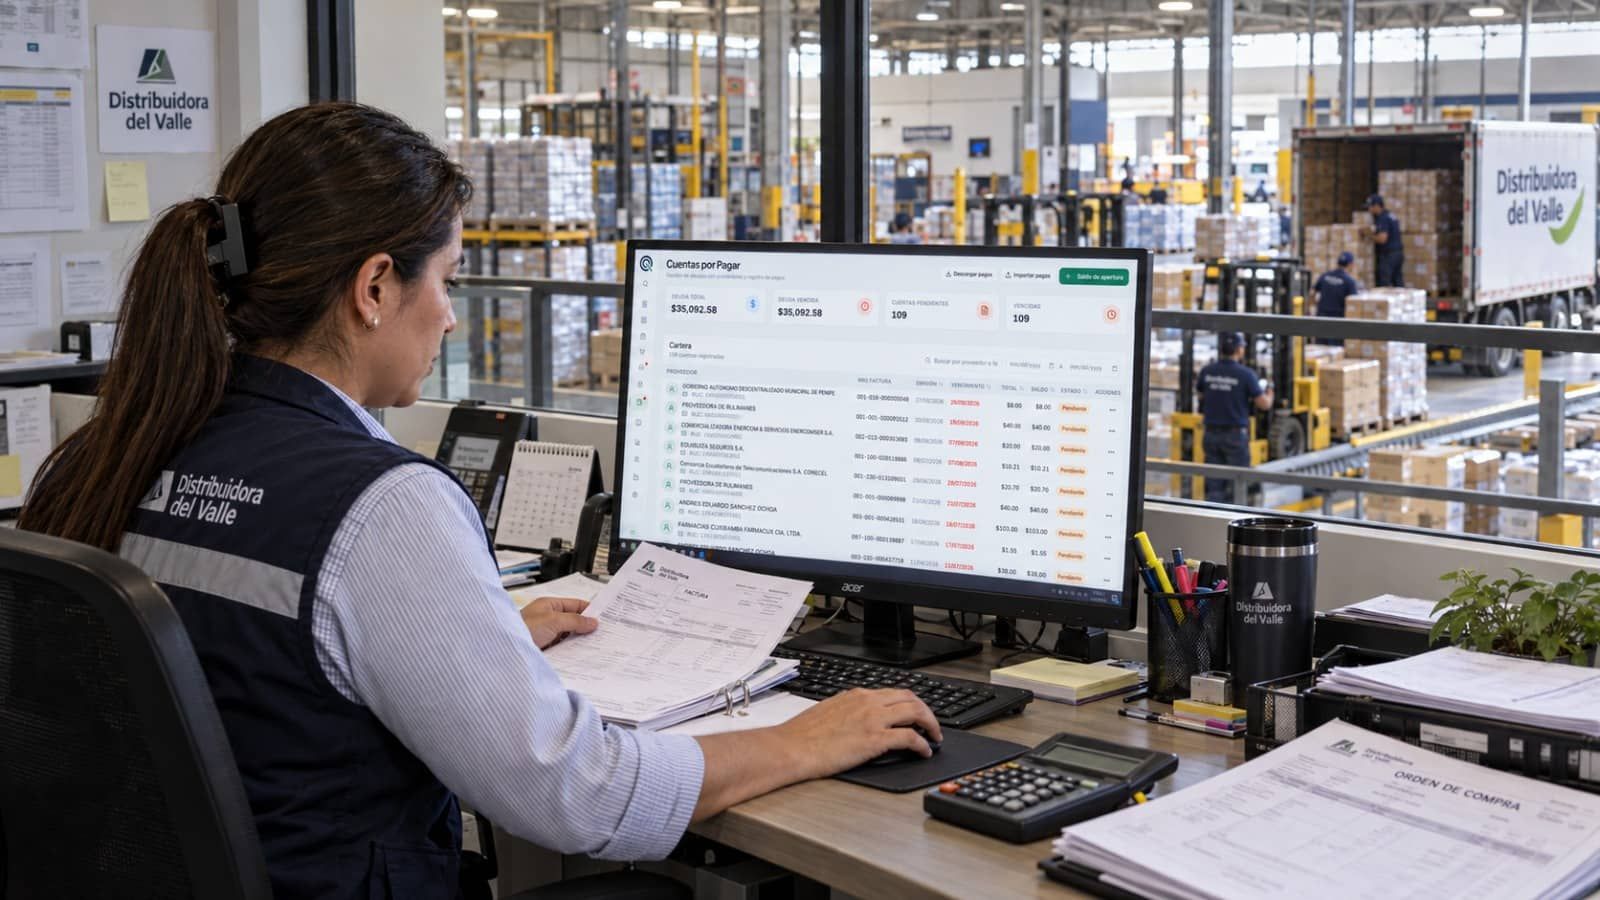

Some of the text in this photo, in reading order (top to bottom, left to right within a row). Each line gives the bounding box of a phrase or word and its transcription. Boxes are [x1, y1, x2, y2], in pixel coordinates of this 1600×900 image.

[109, 92, 209, 110] Distribuidora
[126, 113, 193, 130] del Valle
[1497, 164, 1577, 194] Distribuidora
[1508, 197, 1563, 225] del Valle
[666, 259, 741, 272] Cuentas por Pagar
[671, 304, 717, 315] $35,092.58
[778, 308, 822, 318] $35,092.58
[892, 311, 907, 319] 109
[1013, 314, 1030, 323] 109
[669, 342, 692, 350] Cartera
[176, 473, 264, 505] Distribuidora
[169, 495, 237, 526] del Valle
[679, 499, 778, 513] ANDRES EDUARDO SANCHEZ OCHOA
[684, 589, 709, 599] FACTURA
[841, 583, 864, 593] acer
[1236, 602, 1292, 613] Distribuidora
[1243, 614, 1284, 625] del Valle
[1394, 770, 1440, 788] ORDEN
[1441, 783, 1462, 795] DE
[1463, 790, 1521, 811] COMPRA
